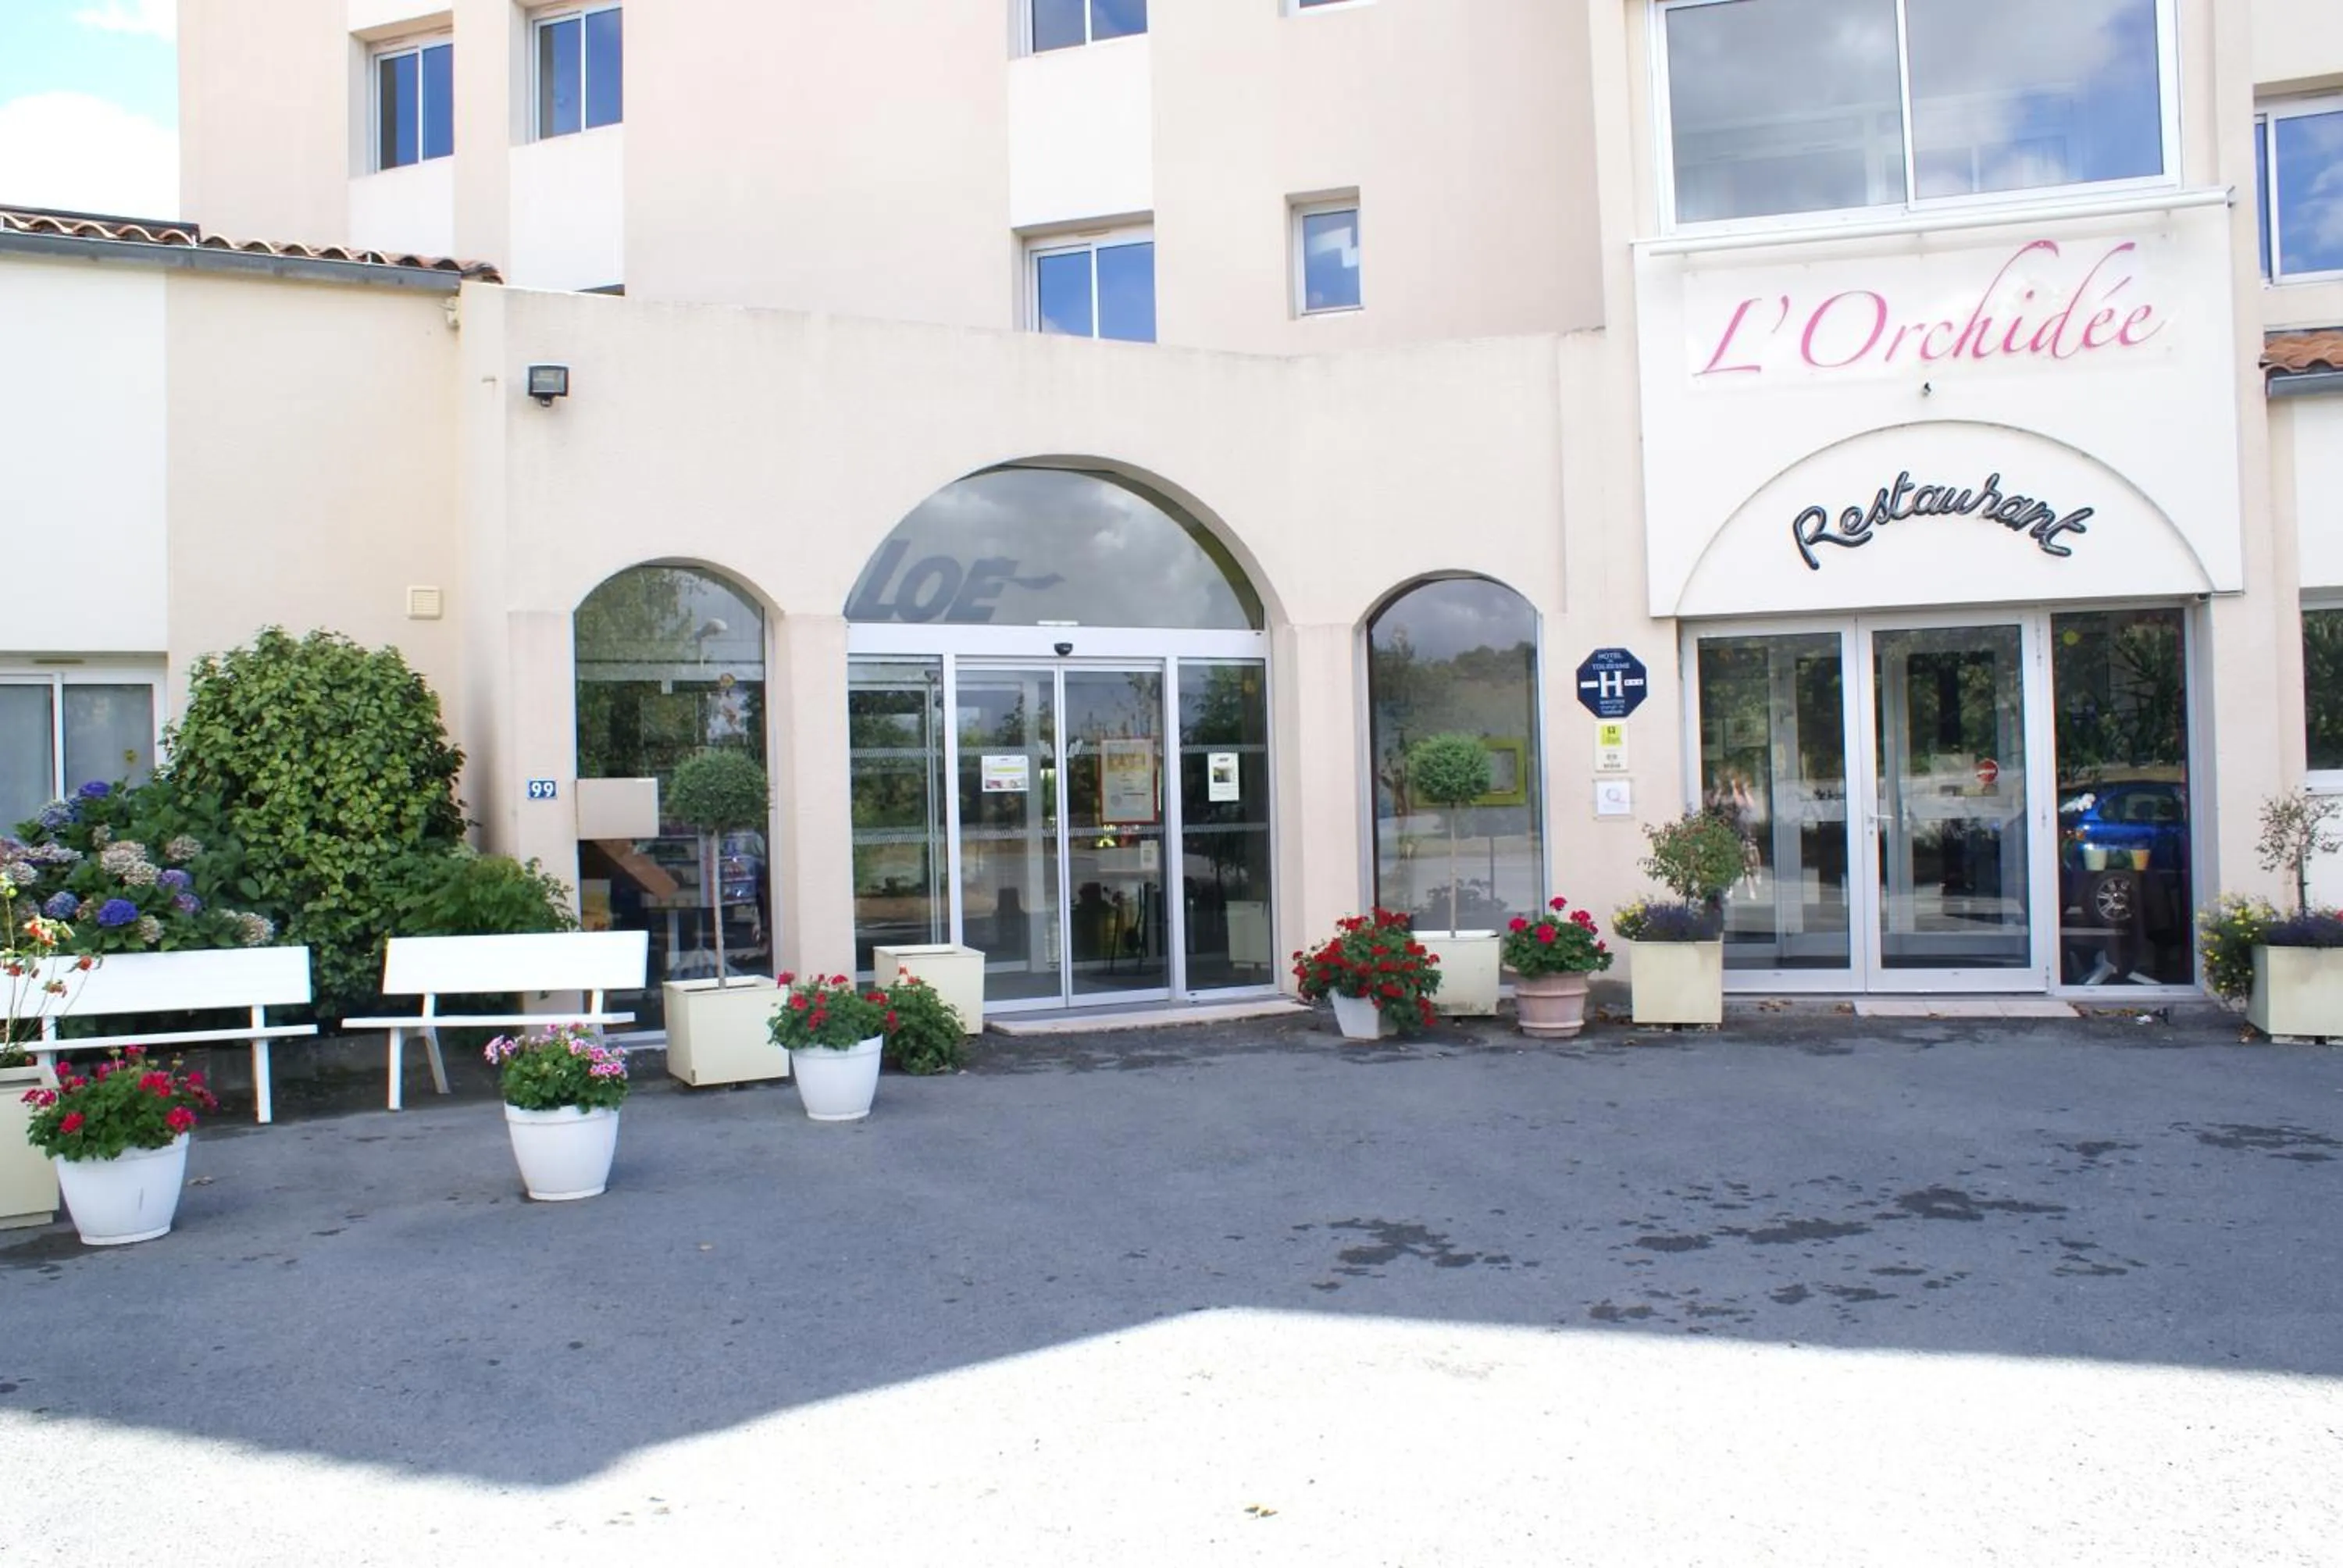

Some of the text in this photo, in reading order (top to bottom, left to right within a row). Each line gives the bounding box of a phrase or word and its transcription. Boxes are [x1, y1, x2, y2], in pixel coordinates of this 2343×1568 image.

[1691, 240, 2166, 377] L'Orchidée
[1793, 471, 2095, 570] Restaurant
[1599, 671, 1624, 698] H
[532, 782, 554, 797] 99
